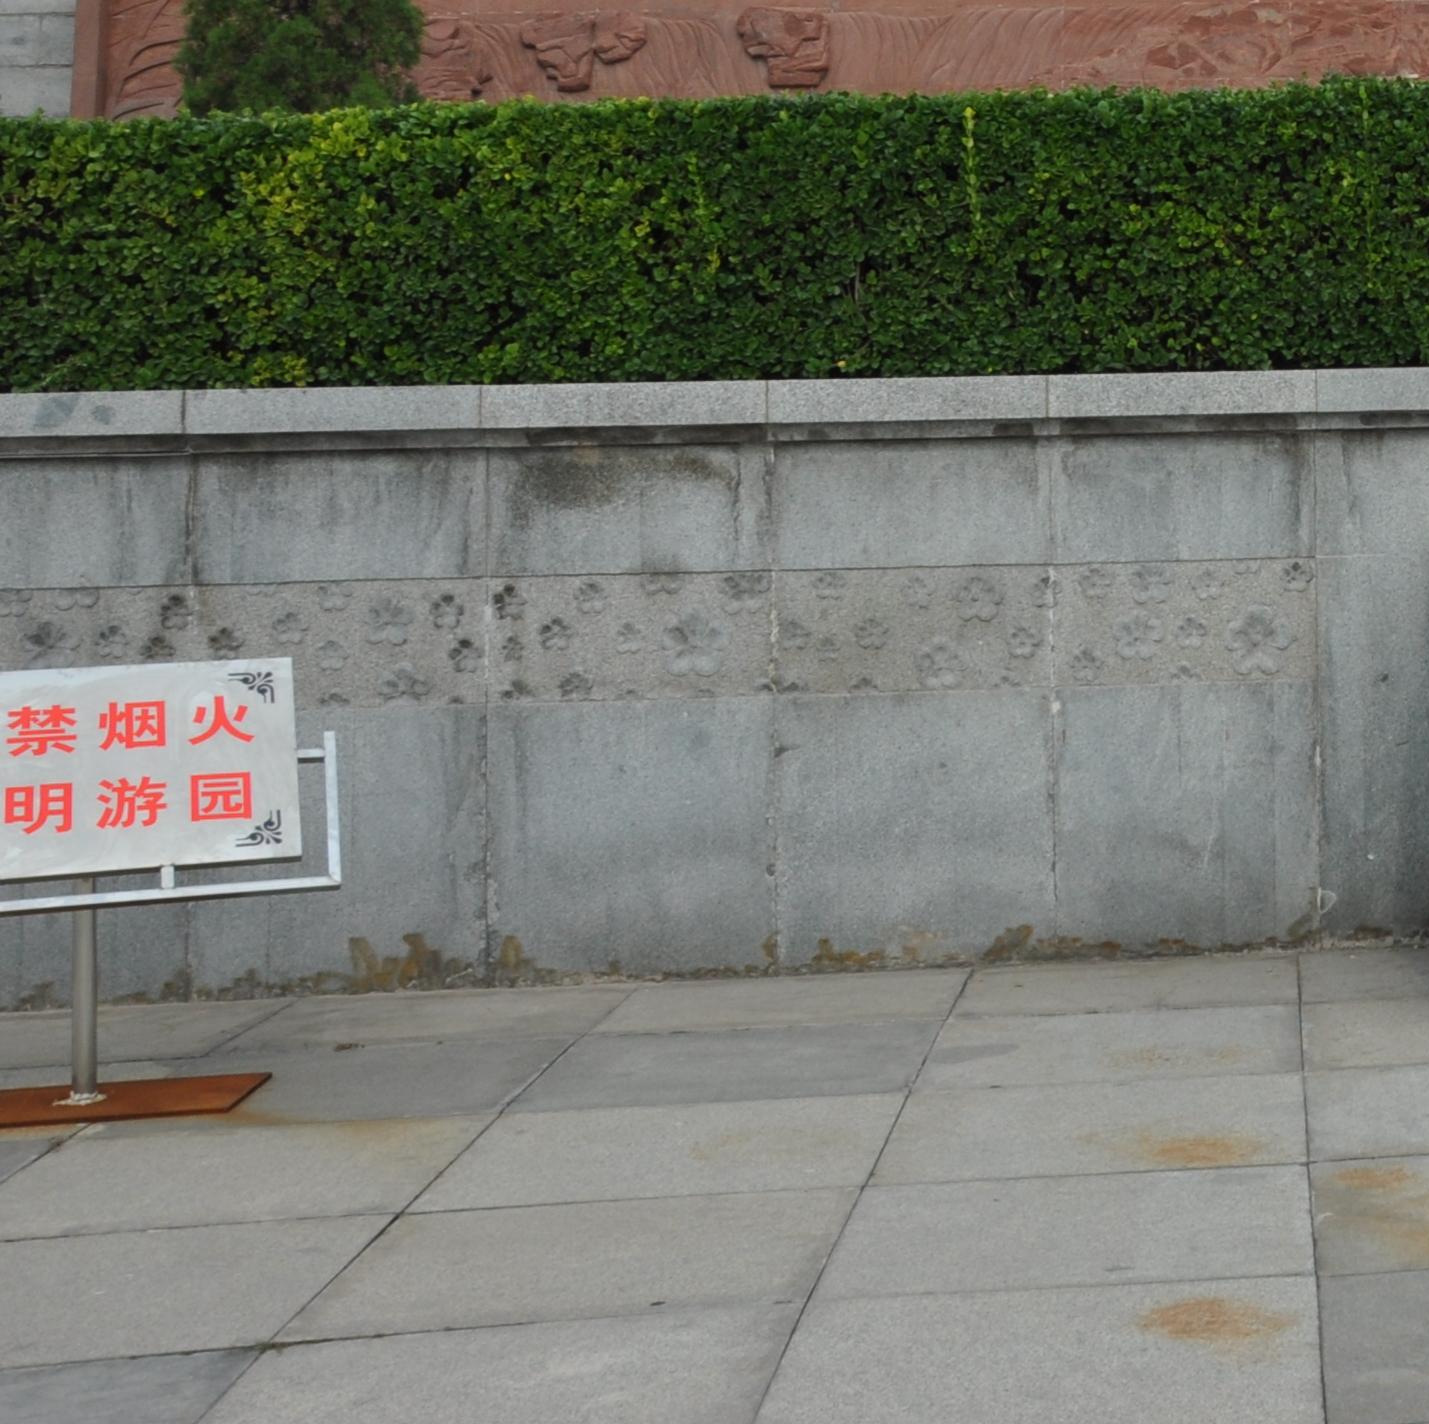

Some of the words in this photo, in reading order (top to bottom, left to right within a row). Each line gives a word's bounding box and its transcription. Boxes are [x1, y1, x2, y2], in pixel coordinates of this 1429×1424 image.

[6, 695, 255, 757] 禁烟火
[4, 771, 252, 835] 明游园
